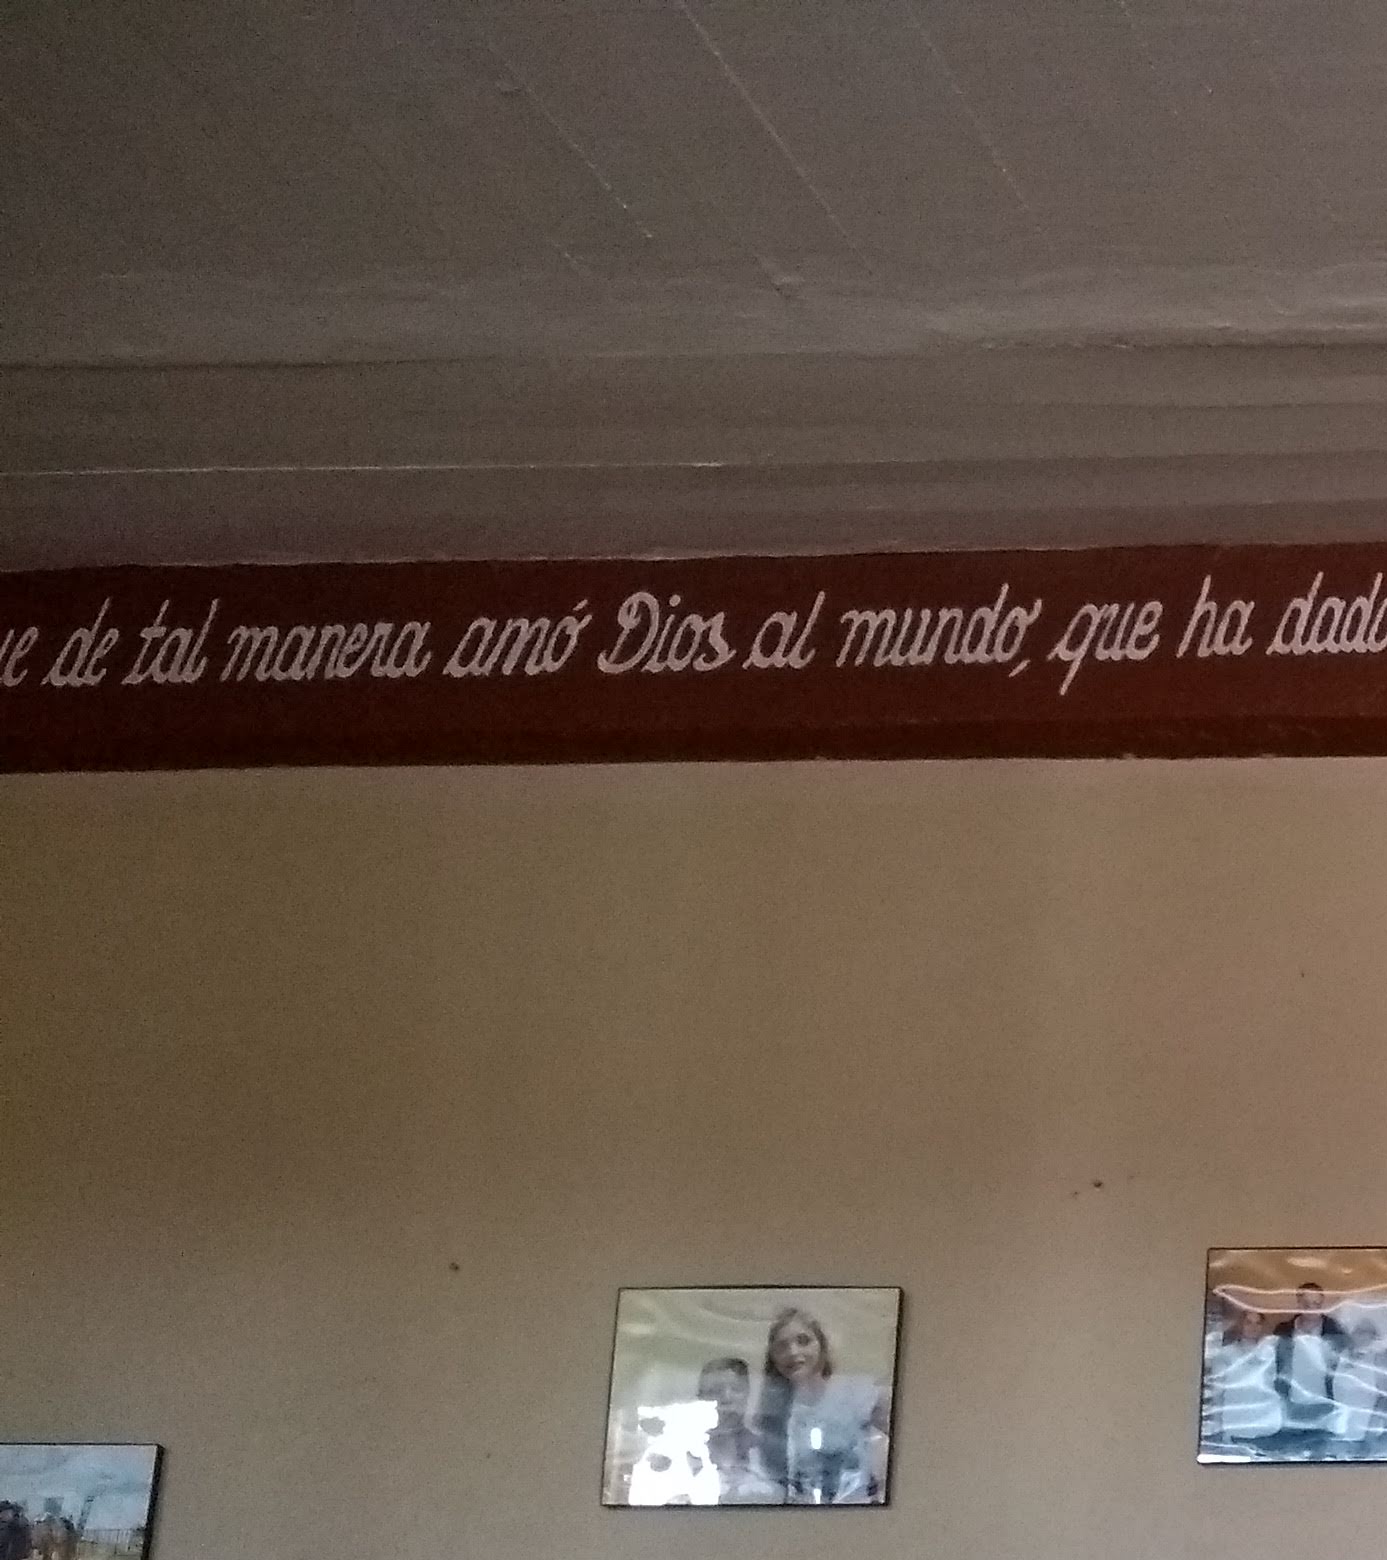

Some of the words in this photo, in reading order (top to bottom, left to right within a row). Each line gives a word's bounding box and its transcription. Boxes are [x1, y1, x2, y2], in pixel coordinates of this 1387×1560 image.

[41, 597, 120, 688] de
[122, 598, 220, 685] tal
[221, 621, 432, 682] manera
[443, 598, 592, 678] amó
[597, 590, 737, 674] Dios
[742, 590, 826, 670] al
[836, 583, 1043, 678] mundo,
[1047, 600, 1164, 696] que
[1175, 575, 1256, 659] ha
